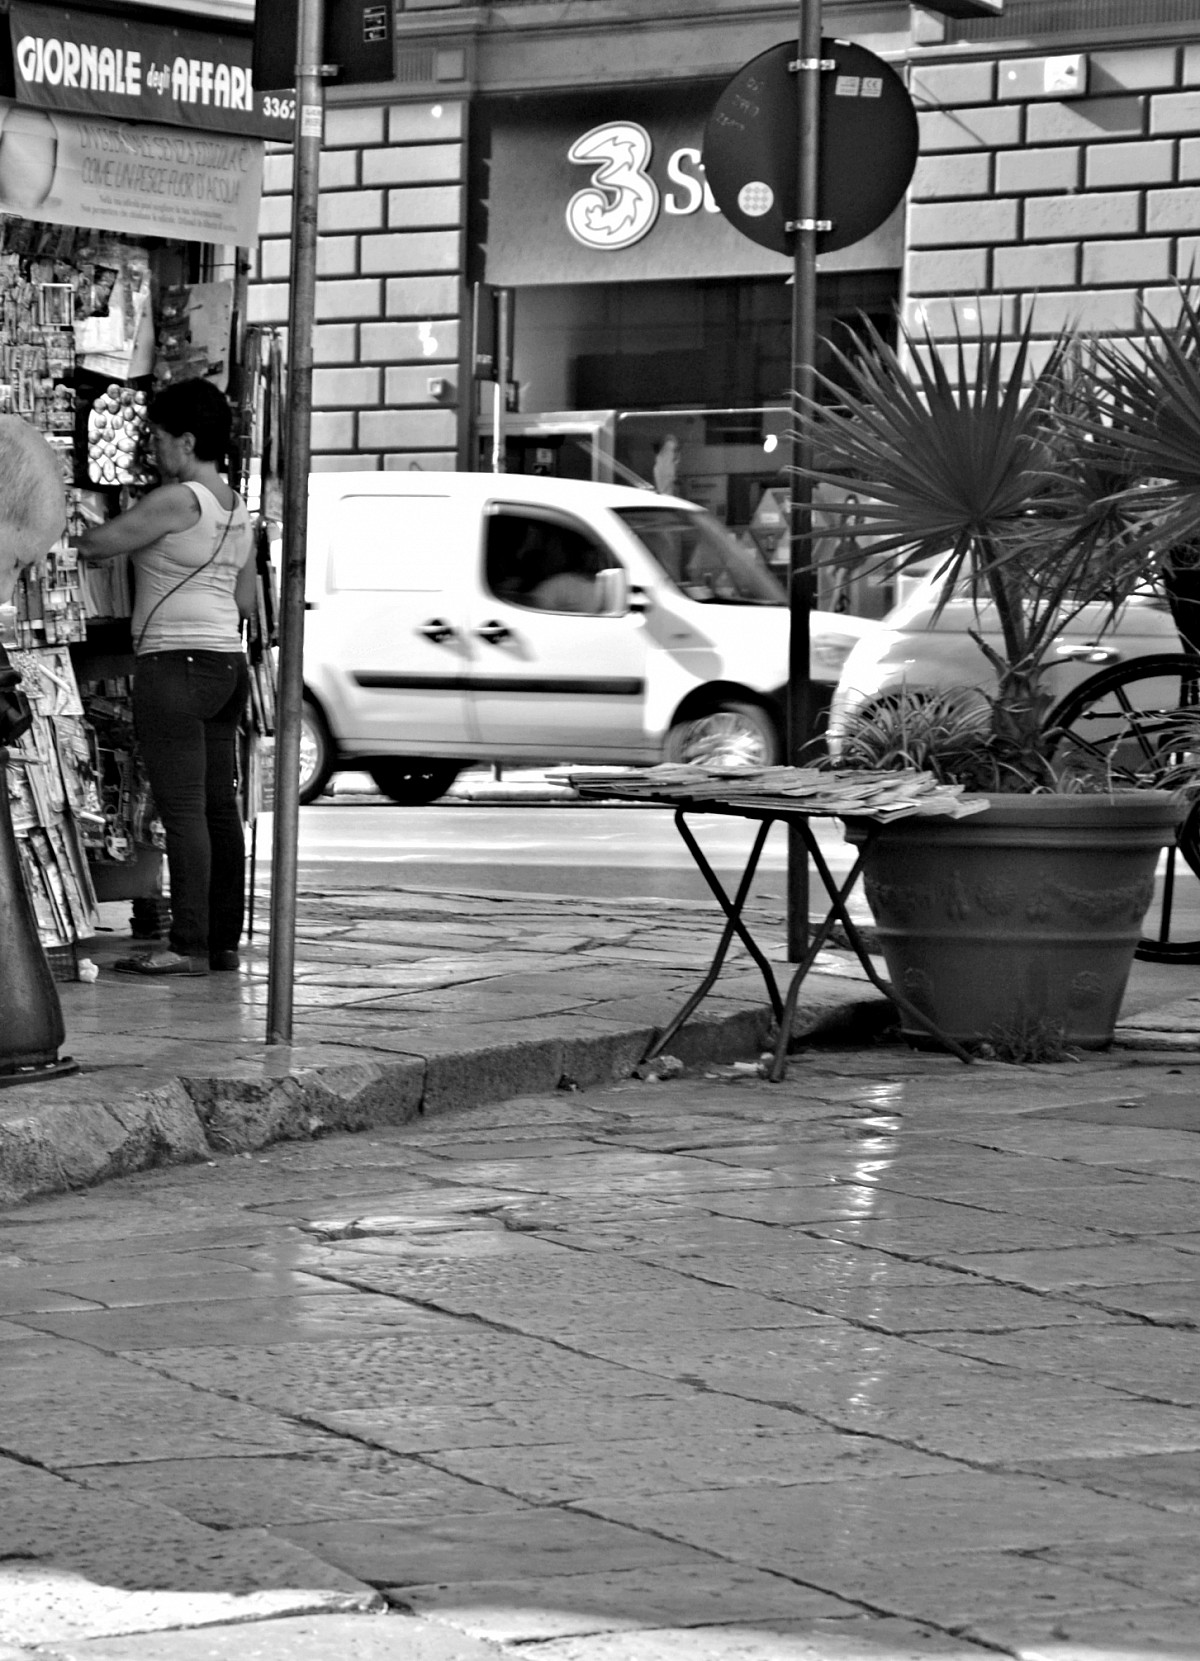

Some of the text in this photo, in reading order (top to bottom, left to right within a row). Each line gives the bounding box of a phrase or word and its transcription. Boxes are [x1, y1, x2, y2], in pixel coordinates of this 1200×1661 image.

[17, 36, 141, 96] GIORNALE
[147, 63, 170, 95] degli
[171, 57, 253, 111] AFFARI
[566, 120, 660, 250] 3
